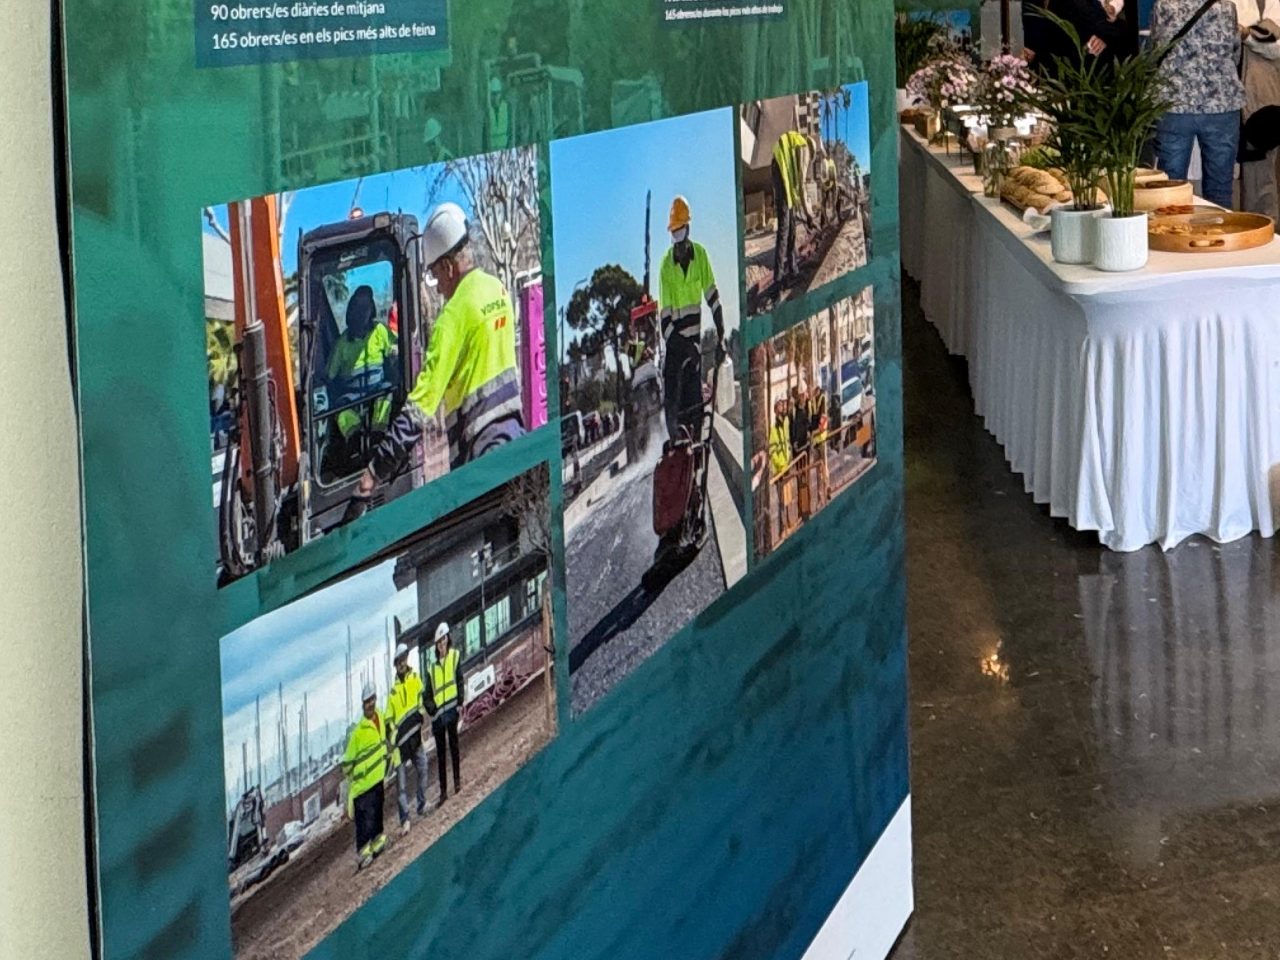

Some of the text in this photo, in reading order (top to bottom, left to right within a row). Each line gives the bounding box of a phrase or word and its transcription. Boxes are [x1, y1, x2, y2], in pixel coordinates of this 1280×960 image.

[211, 1, 385, 20] 90 obrers/es diàries de mitjana
[213, 23, 436, 49] 165 obrers/es en els pics més alts de feina
